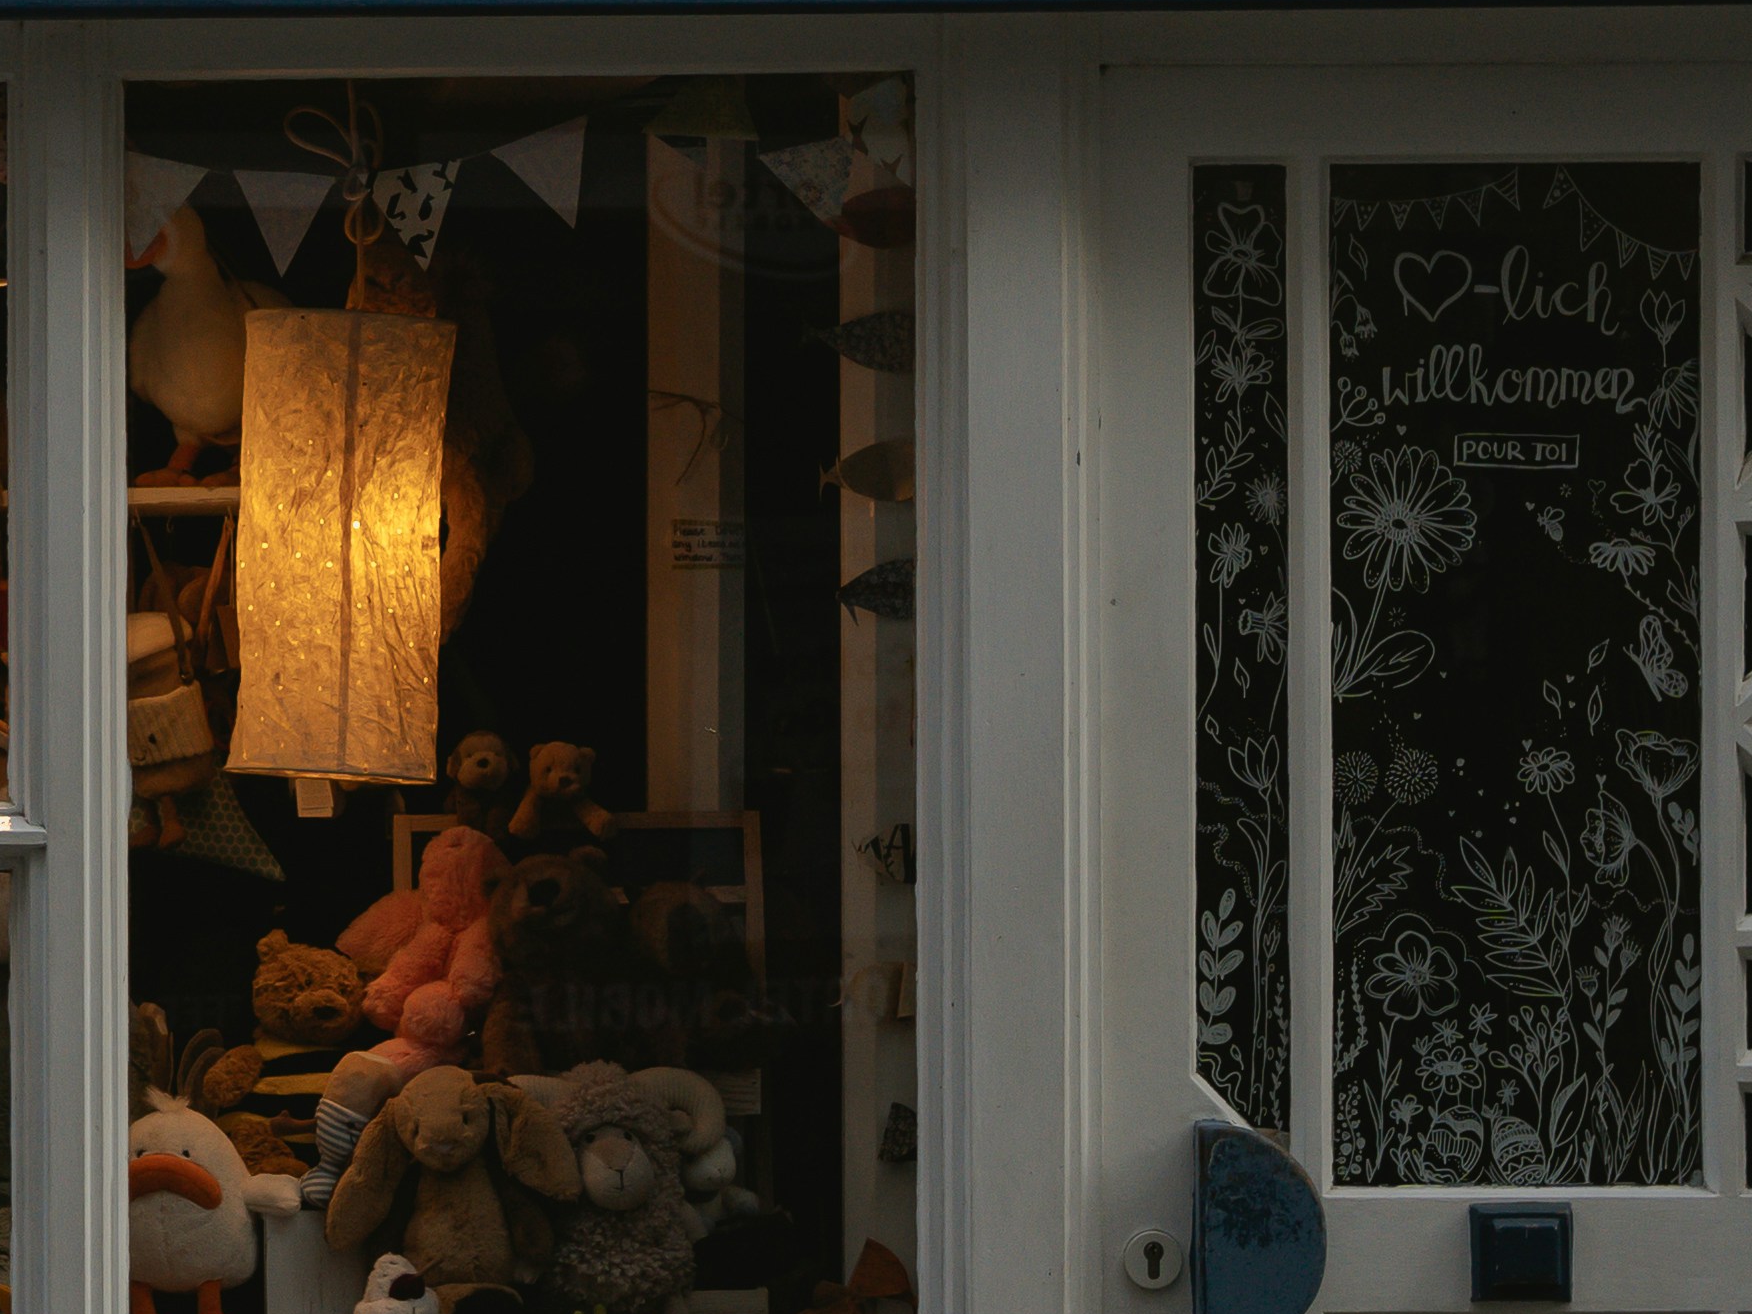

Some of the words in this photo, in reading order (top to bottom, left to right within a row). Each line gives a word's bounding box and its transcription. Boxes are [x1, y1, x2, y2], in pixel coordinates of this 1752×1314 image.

[1382, 344, 1648, 414] willkommen
[1462, 441, 1525, 461] POUR
[1533, 441, 1566, 461] TOI
